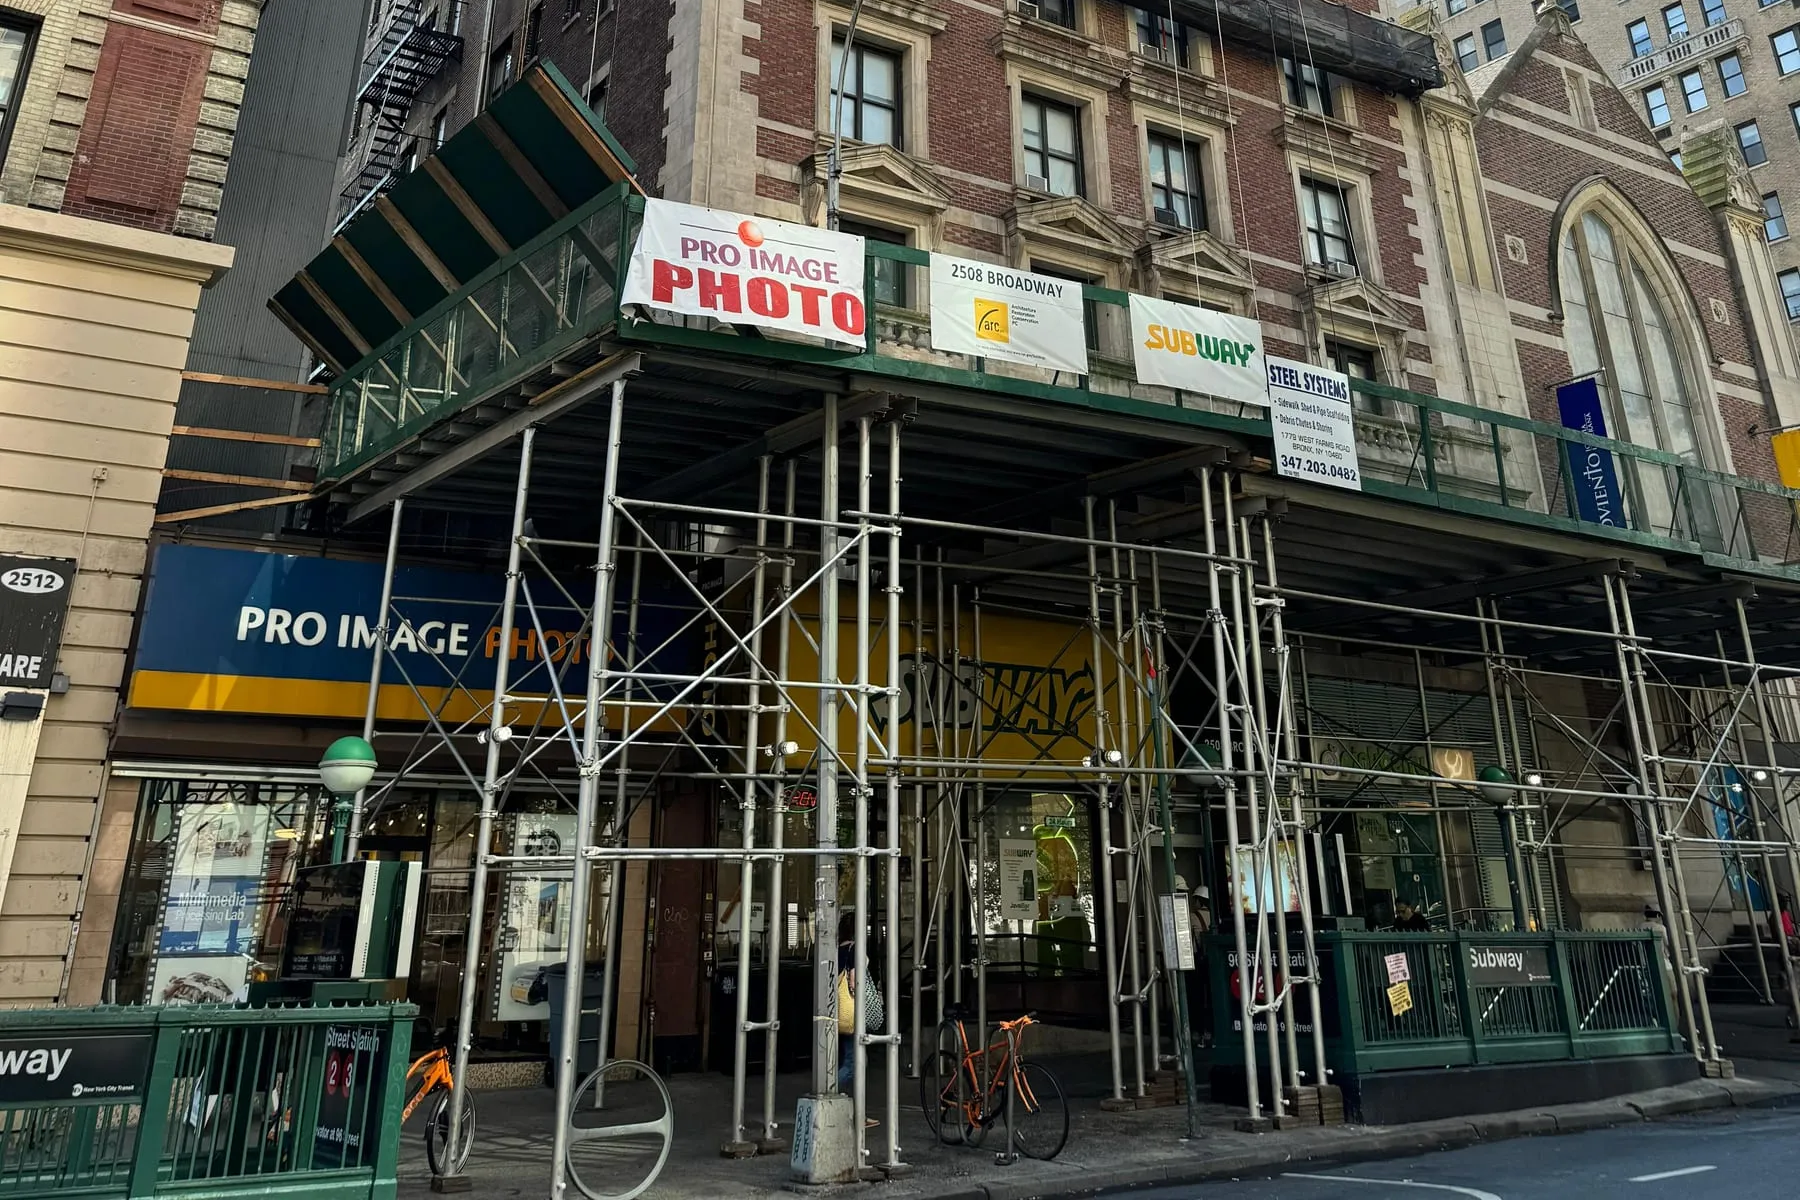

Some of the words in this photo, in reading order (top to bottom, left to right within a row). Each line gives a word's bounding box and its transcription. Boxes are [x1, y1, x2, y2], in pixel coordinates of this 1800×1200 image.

[681, 237, 741, 267] PRO
[749, 248, 840, 284] IMAGE
[951, 263, 983, 283] 2508
[987, 270, 1063, 298] BROADWAY
[652, 258, 865, 336] PHOTO
[984, 319, 1000, 332] arc
[1144, 324, 1256, 368] SUBWAY
[1269, 364, 1302, 388] STEEL
[1303, 372, 1347, 400] SYSTEMS
[1278, 397, 1300, 410] Sidewalk
[1301, 402, 1313, 413] Shed
[1316, 406, 1326, 418] Pipe
[1327, 408, 1350, 424] Scaffolding
[1279, 414, 1296, 427] Debris
[1296, 417, 1312, 430] Chutes
[1316, 421, 1333, 436] Shoring
[1292, 443, 1314, 454] BRONX,
[1298, 435, 1314, 444] WEST
[1315, 438, 1335, 449] FARMS
[1335, 443, 1351, 453] ROAD
[1281, 454, 1357, 482] 347.203.0482
[8, 571, 56, 589] 2512
[236, 606, 328, 646] PRO
[337, 613, 469, 657] IMAGE
[0, 653, 42, 679] ARE
[868, 653, 1097, 737] SUBWAY
[1003, 848, 1034, 858] SUBWAY
[178, 892, 248, 907] Multimedia
[175, 909, 223, 924] Processing
[225, 908, 245, 921] Lab
[1469, 947, 1523, 971] Subway
[327, 1026, 351, 1049] Street
[328, 1060, 338, 1084] 2
[345, 1062, 353, 1088] 3
[329, 1128, 336, 1141] at
[335, 1127, 343, 1143] 96
